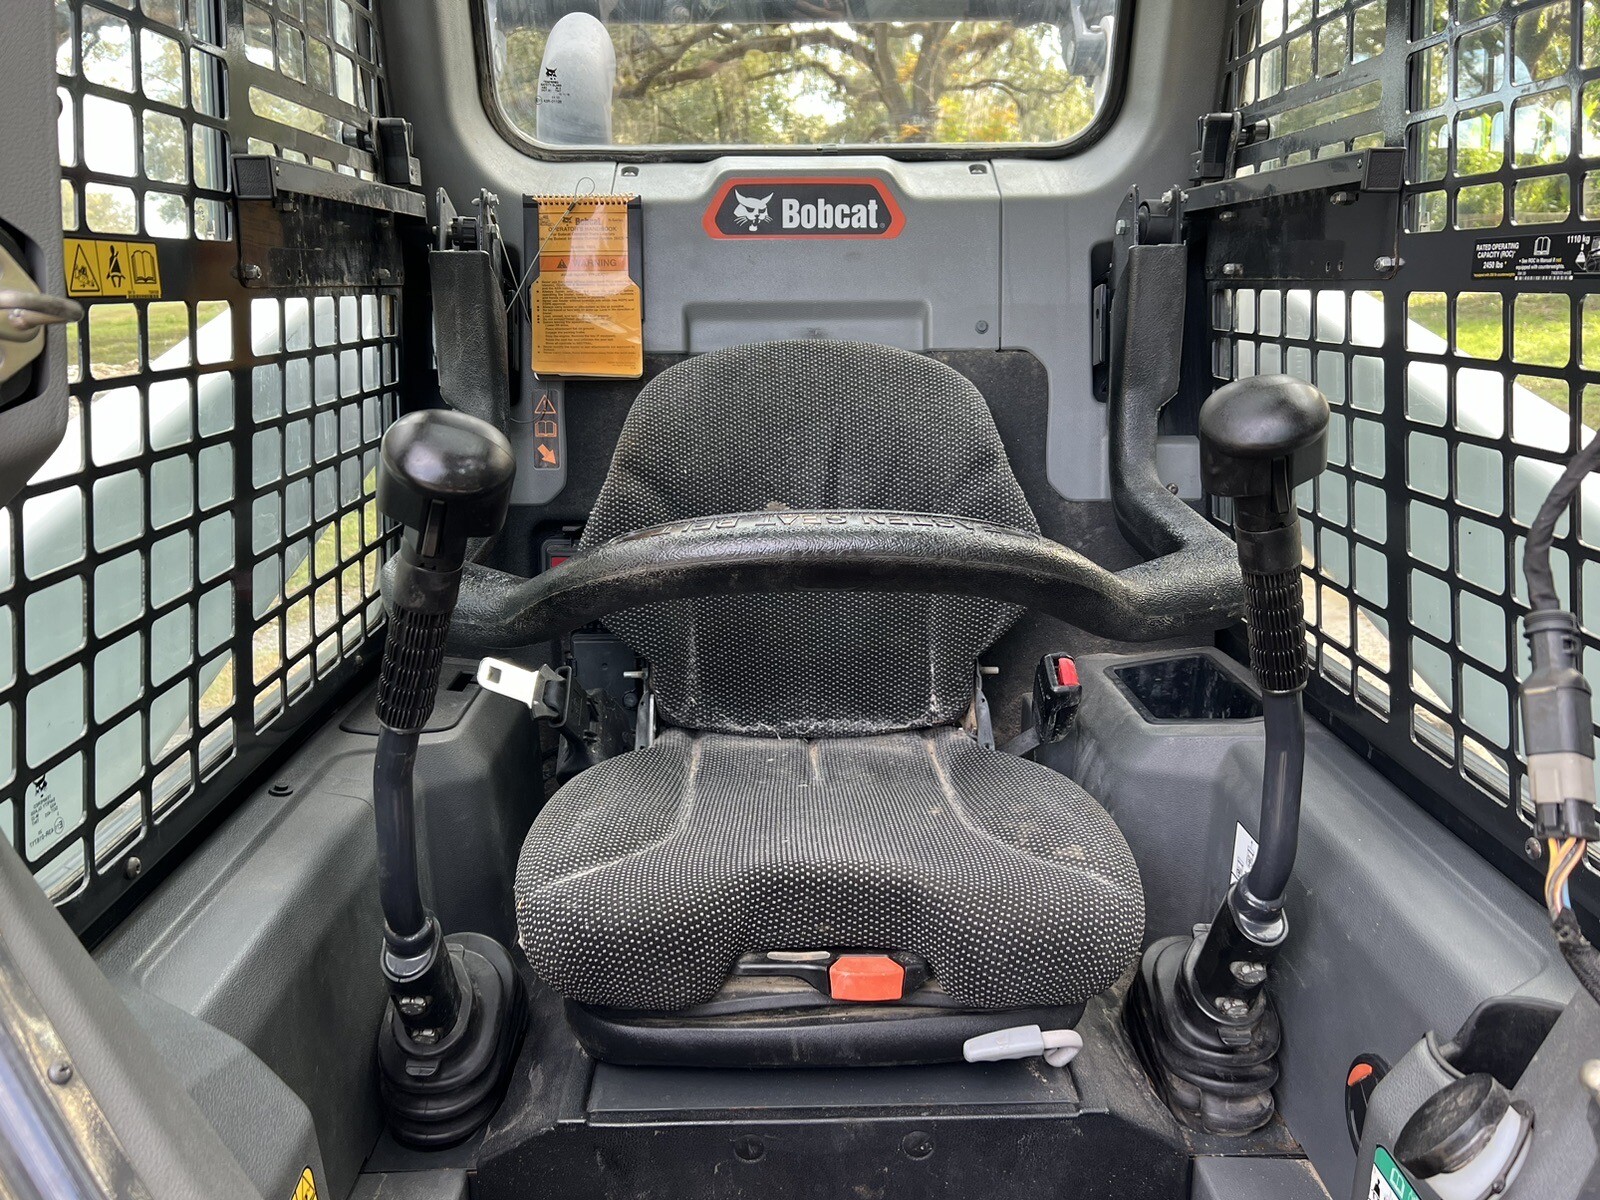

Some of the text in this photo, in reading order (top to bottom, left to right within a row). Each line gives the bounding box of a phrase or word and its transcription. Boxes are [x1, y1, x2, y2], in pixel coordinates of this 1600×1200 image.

[782, 198, 878, 229] Bobcat
[1567, 234, 1590, 244] 1110 kg
[1491, 242, 1519, 250] OPERATING
[1477, 251, 1500, 259] CAPACITY
[572, 259, 617, 267] WARNING
[1495, 260, 1503, 269] lbs
[755, 514, 846, 526] SEAT
